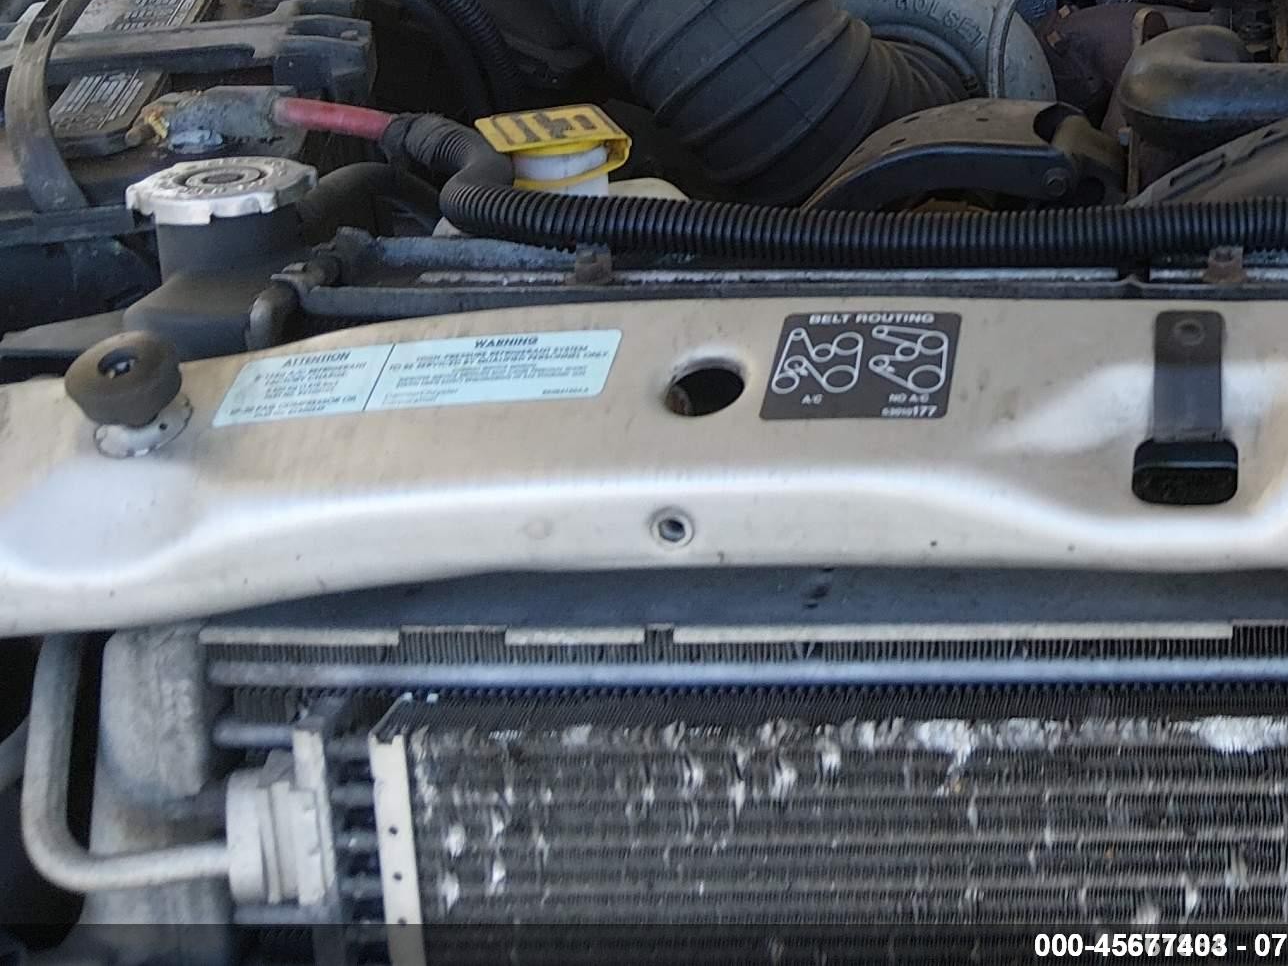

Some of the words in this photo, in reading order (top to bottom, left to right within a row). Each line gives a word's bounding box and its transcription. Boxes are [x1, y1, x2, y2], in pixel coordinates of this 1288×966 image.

[808, 313, 851, 325] BELT
[854, 312, 934, 324] ROUTING
[474, 336, 539, 349] WARNING
[281, 351, 352, 368] ATTENTION
[888, 393, 907, 403] NO
